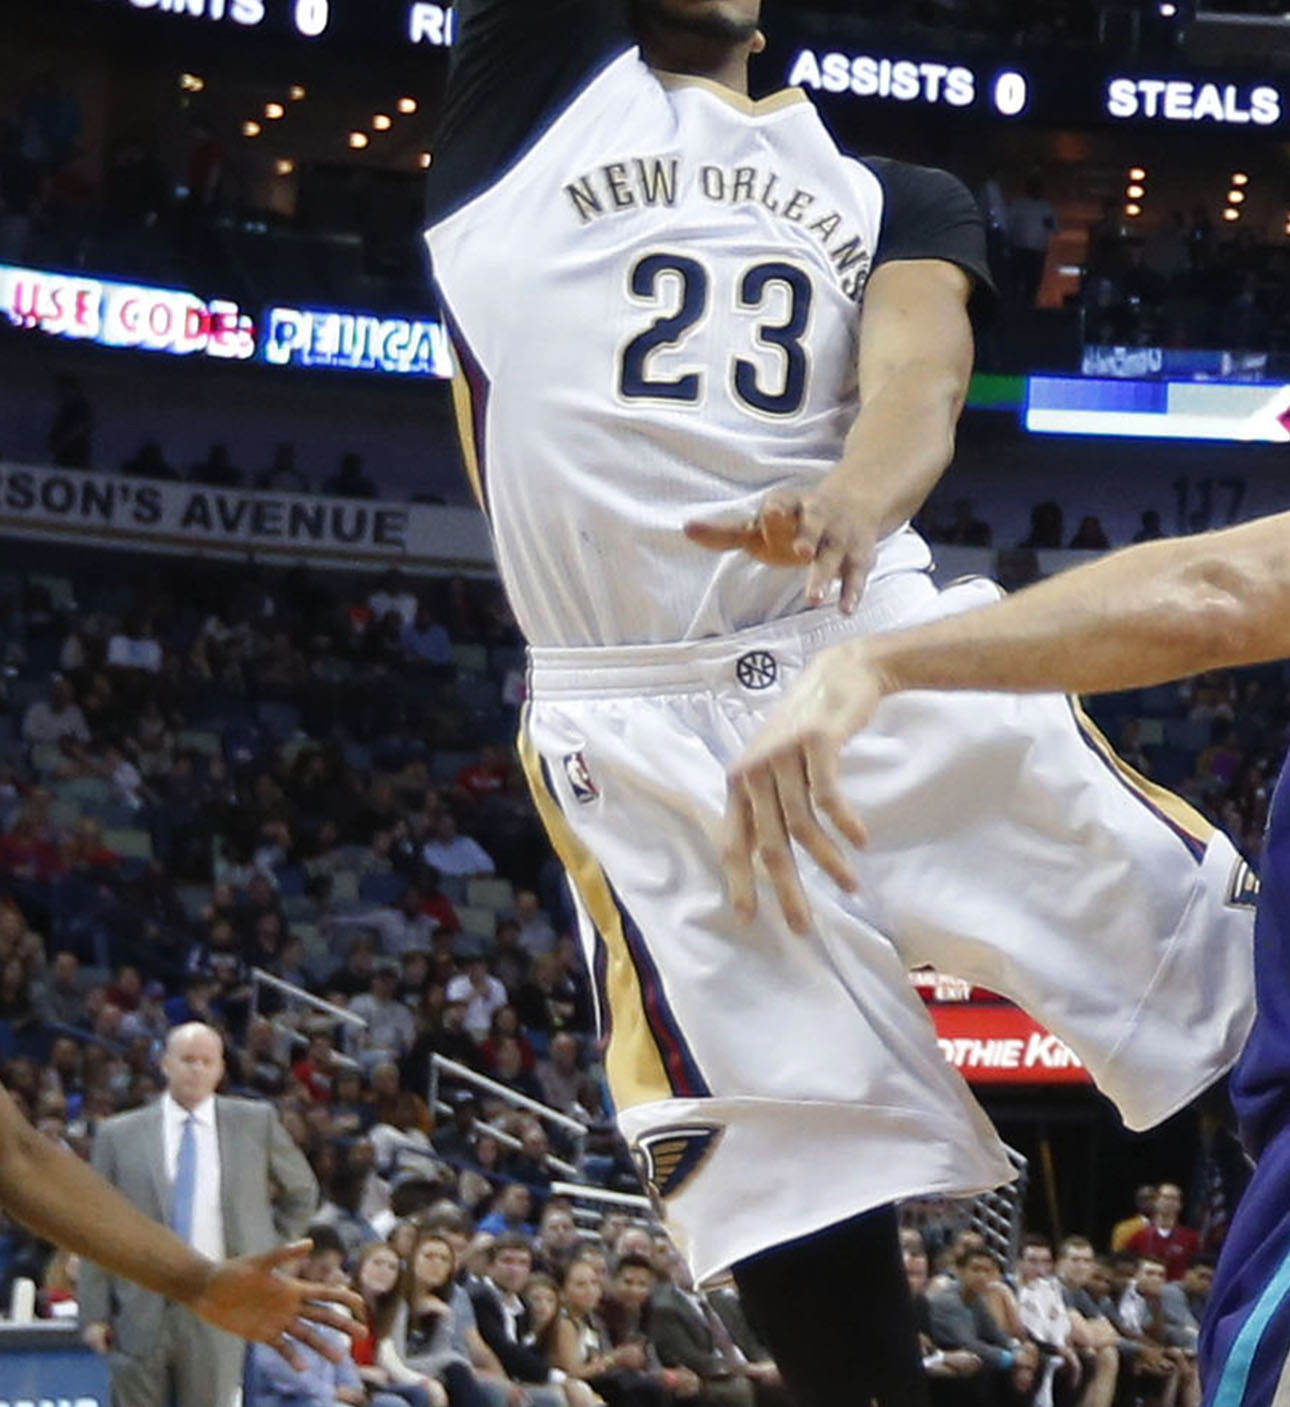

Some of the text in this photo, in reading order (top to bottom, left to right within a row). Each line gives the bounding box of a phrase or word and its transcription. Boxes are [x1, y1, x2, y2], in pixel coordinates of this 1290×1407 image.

[788, 48, 976, 107] ASSISTS
[995, 71, 1027, 116] 0
[1107, 78, 1281, 125] STEALS
[563, 154, 870, 303] NEW ORLEANS
[12, 278, 96, 325] USE
[616, 247, 813, 419] 23
[180, 498, 408, 549] AVENUE
